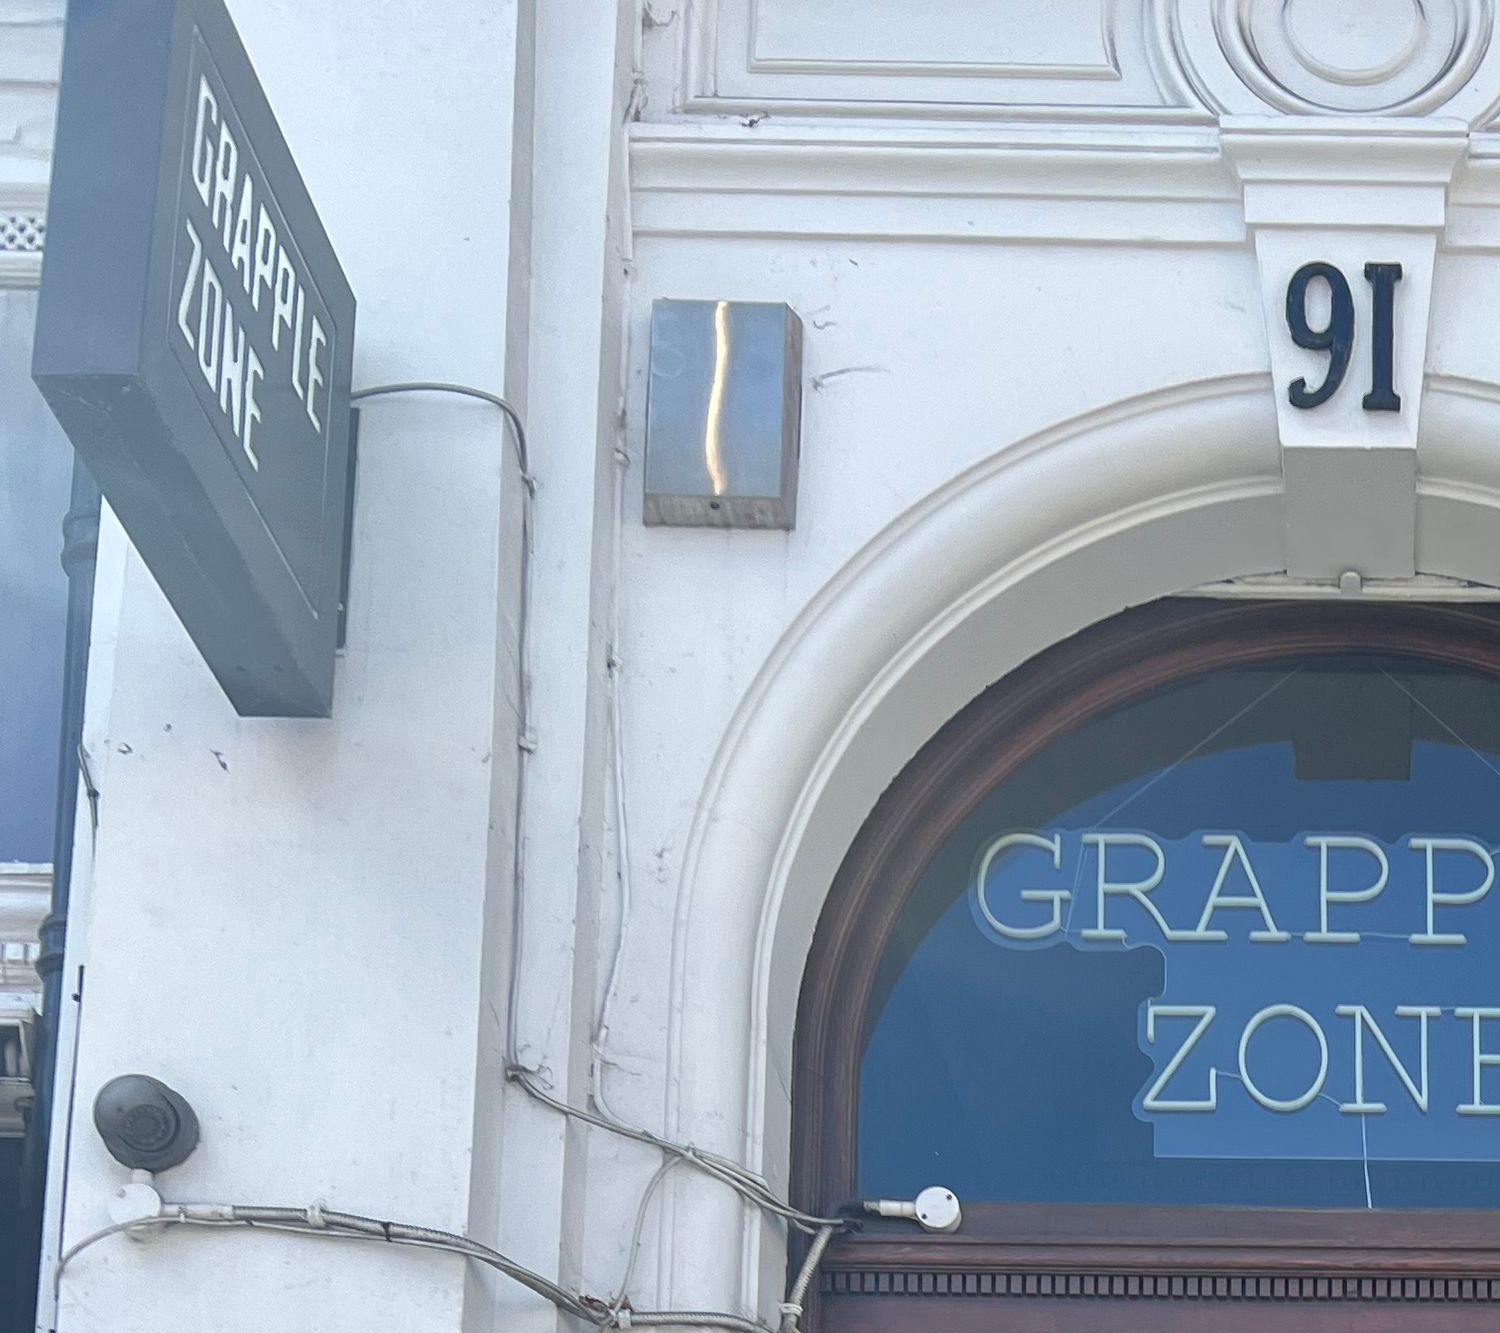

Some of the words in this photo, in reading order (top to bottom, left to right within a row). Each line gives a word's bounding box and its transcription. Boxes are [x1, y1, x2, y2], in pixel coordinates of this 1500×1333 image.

[177, 218, 265, 473] ZONE
[192, 73, 327, 434] GRAPPLE
[1285, 261, 1402, 412] 91
